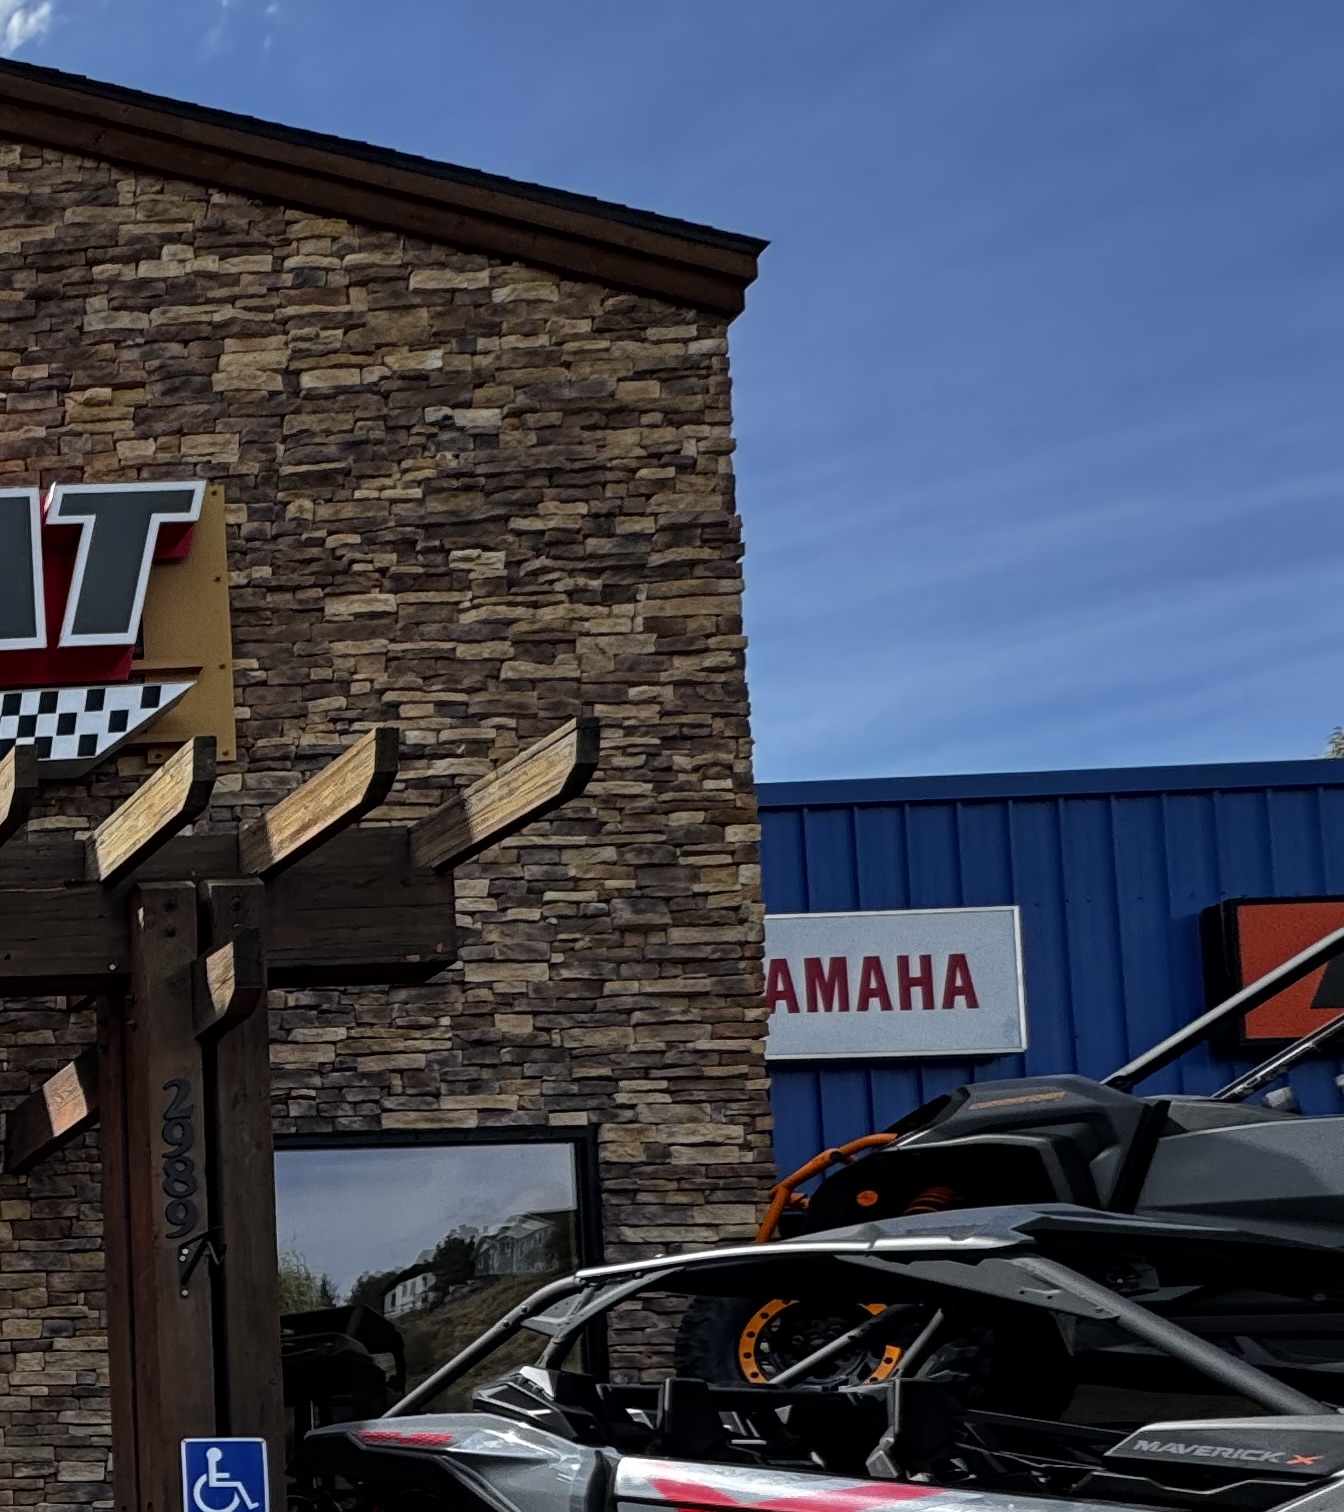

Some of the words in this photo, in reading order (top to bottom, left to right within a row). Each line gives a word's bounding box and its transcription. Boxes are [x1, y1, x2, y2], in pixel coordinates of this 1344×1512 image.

[766, 953, 979, 1014] AMAHA
[162, 1078, 199, 1239] 2989
[1133, 1440, 1286, 1464] MAVERICK
